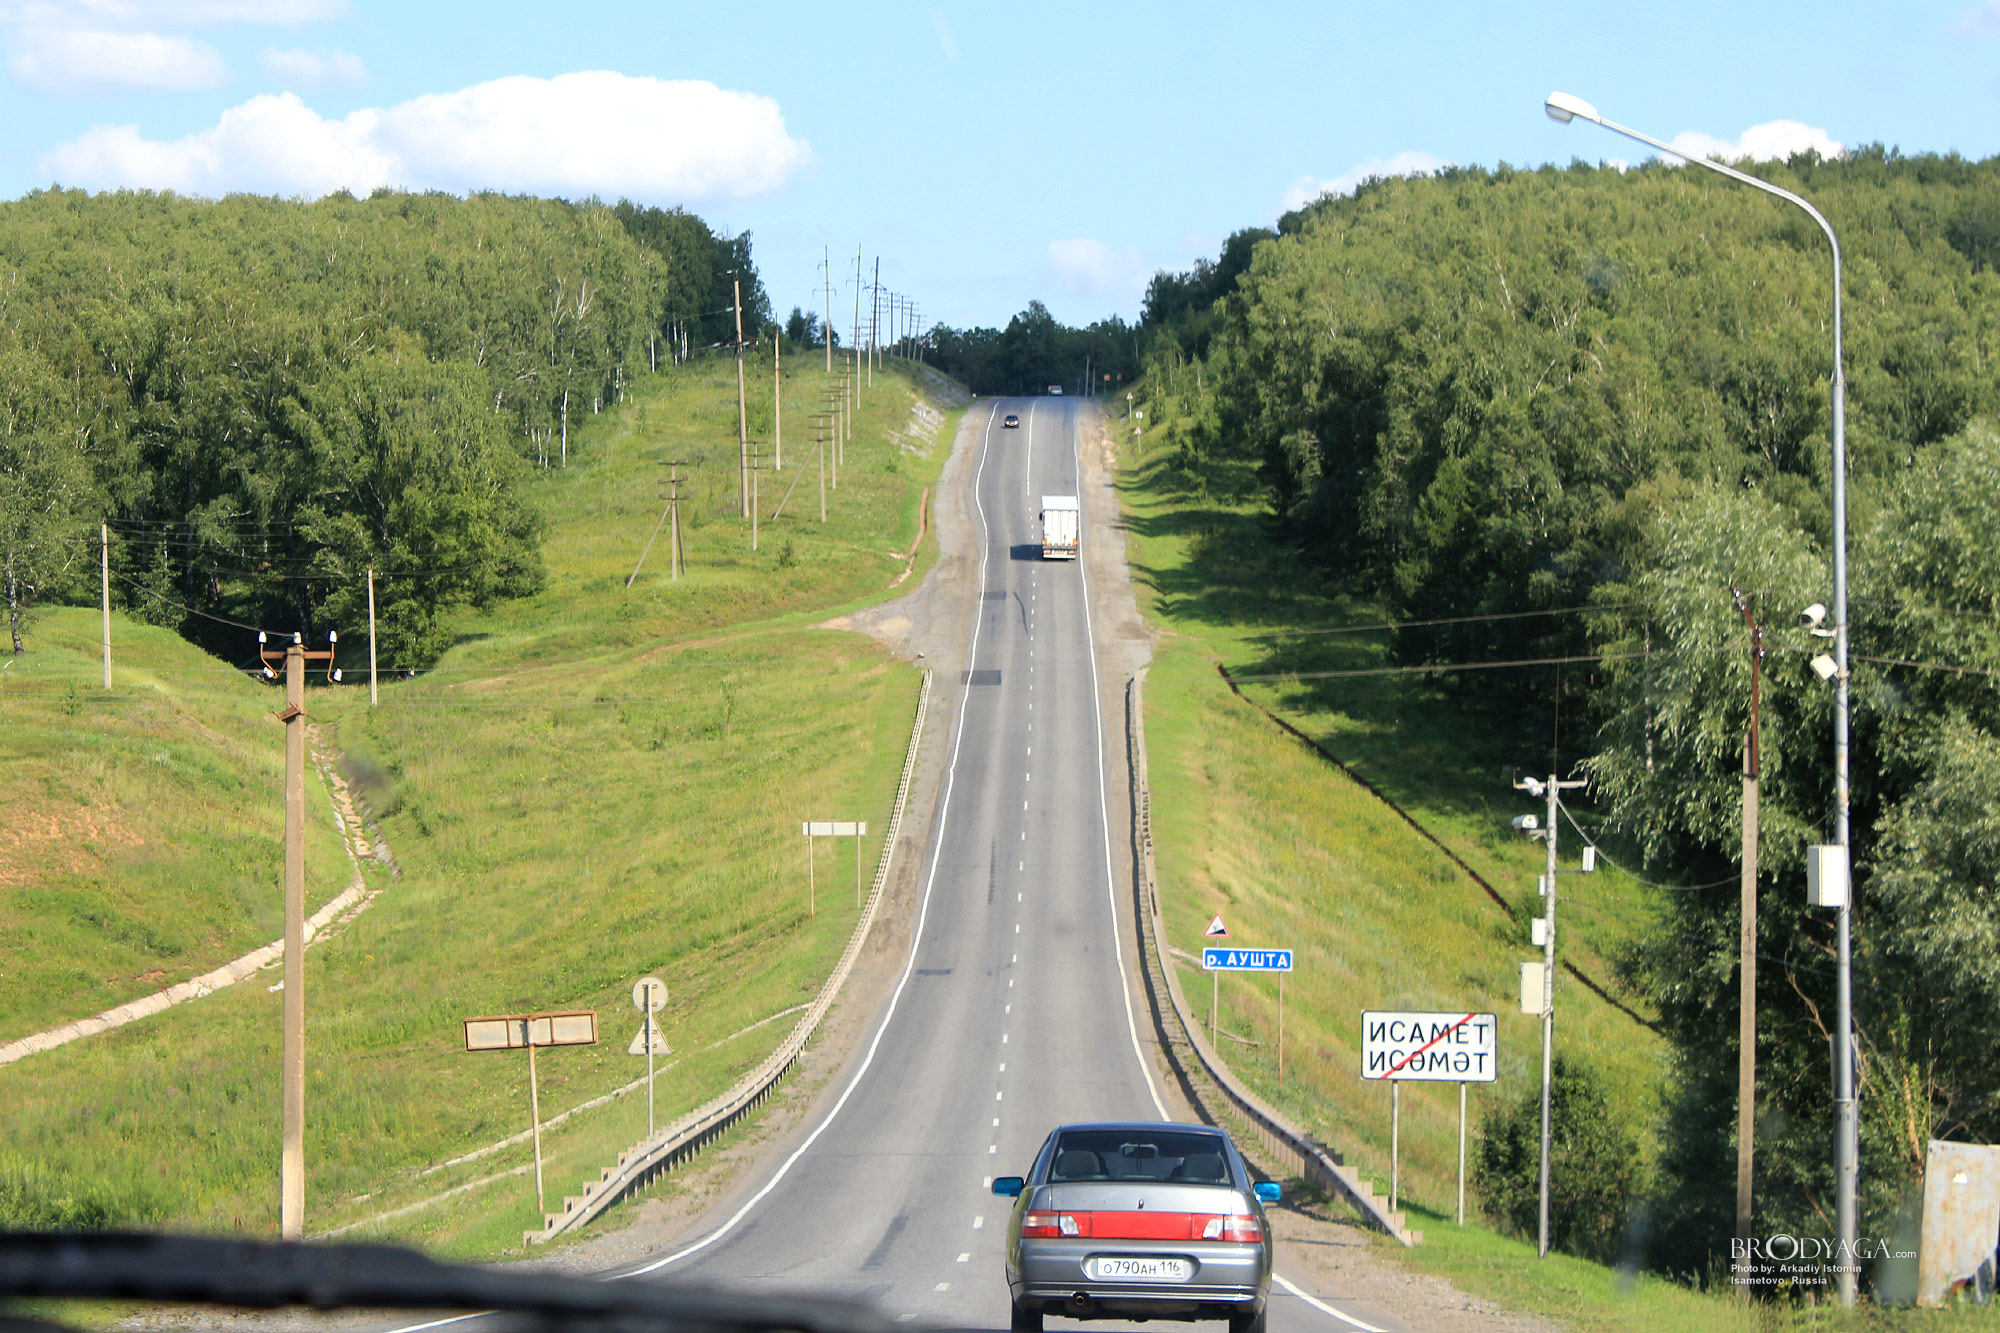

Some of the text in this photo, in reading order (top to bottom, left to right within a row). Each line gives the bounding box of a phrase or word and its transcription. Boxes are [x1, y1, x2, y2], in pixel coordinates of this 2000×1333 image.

[1207, 952, 1288, 968] р. АУШТА
[1369, 1020, 1489, 1045] ИСАМЕТ
[1159, 1261, 1180, 1272] 116
